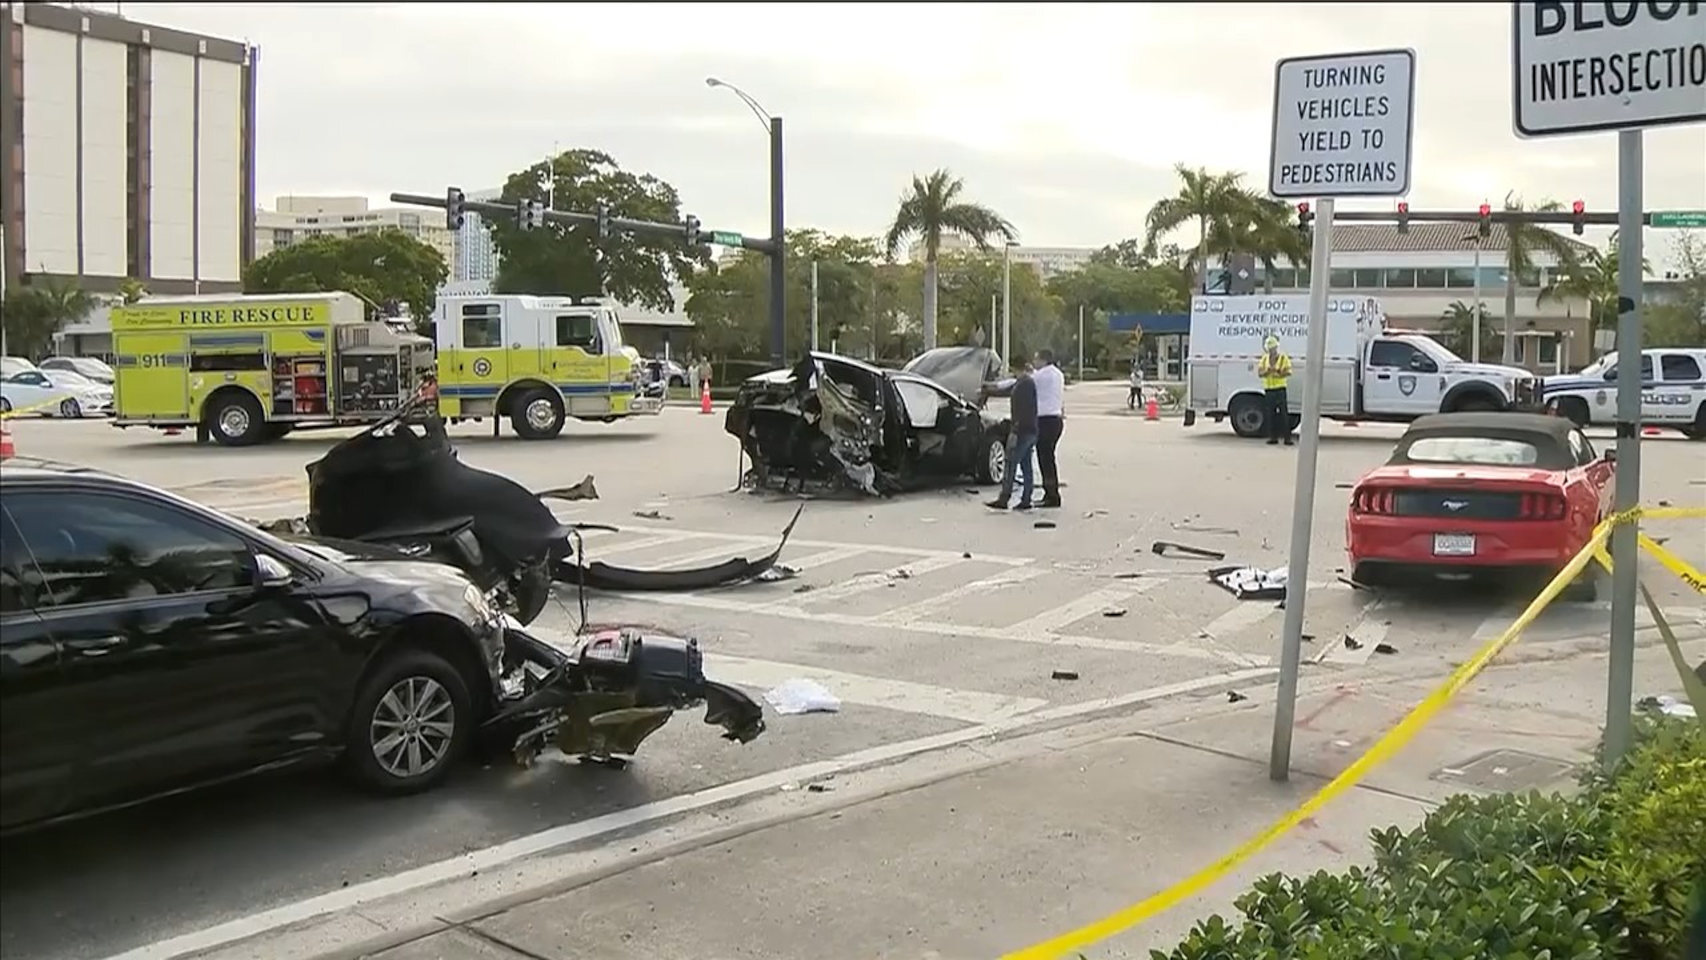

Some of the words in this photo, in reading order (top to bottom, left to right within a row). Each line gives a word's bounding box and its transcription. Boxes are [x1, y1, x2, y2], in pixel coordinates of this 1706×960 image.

[1303, 64, 1385, 89] TURNING
[1297, 95, 1390, 120] VEHICLES
[1299, 130, 1351, 152] YIELD
[1361, 128, 1384, 150] TO
[1280, 161, 1397, 185] PEDESTRIANS
[179, 309, 226, 325] FIRE
[232, 307, 315, 324] RESCUE
[1224, 314, 1267, 324] SEVERE
[1269, 314, 1310, 325] INCIDE
[1218, 327, 1276, 337] RESPONSE
[1279, 327, 1309, 337] VEHI
[142, 354, 167, 368] 911
